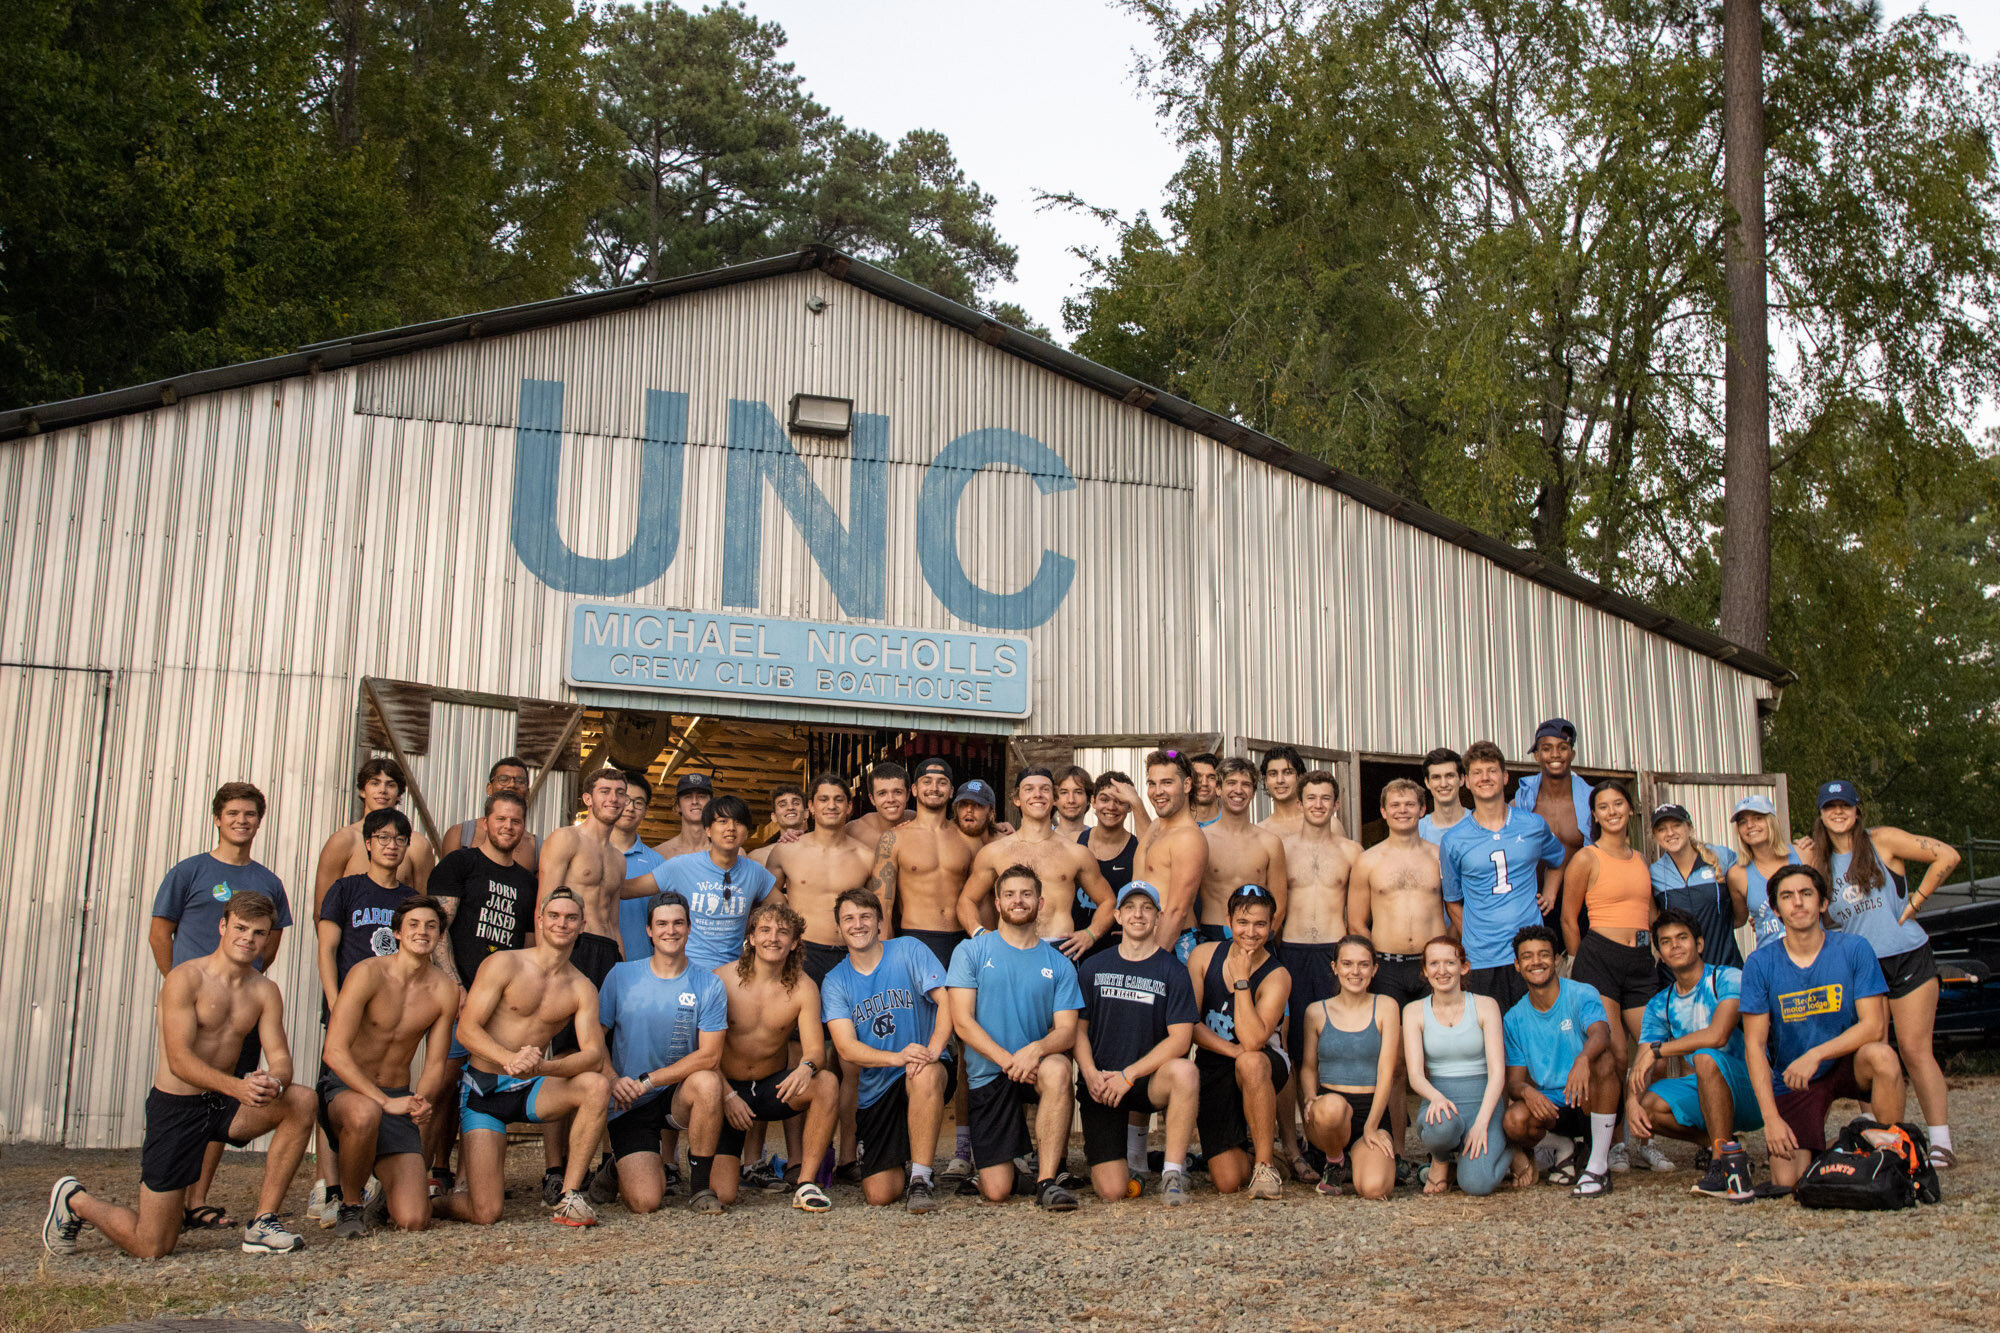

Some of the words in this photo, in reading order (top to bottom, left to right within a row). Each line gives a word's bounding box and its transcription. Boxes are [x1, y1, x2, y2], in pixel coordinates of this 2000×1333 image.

[511, 378, 1077, 630] UNC
[583, 610, 781, 659] MICHAEL
[807, 629, 1018, 679] NICHOLLS
[609, 653, 700, 683] CREW
[716, 662, 795, 689] CLUB
[816, 670, 993, 704] BOATHOUSE
[1488, 848, 1513, 895] 1
[489, 880, 517, 900] BORN
[697, 880, 744, 895] Welcome
[486, 894, 515, 915] JACK.
[479, 907, 516, 931] RAISED
[476, 922, 513, 947] HONEY.
[1094, 973, 1124, 987] NORTH
[1102, 988, 1115, 997] TAR
[1116, 989, 1137, 1000] HEELS
[852, 988, 914, 1029] CAROLINA
[1784, 1004, 1807, 1015] motor
[1819, 1162, 1856, 1176] GIANTS
